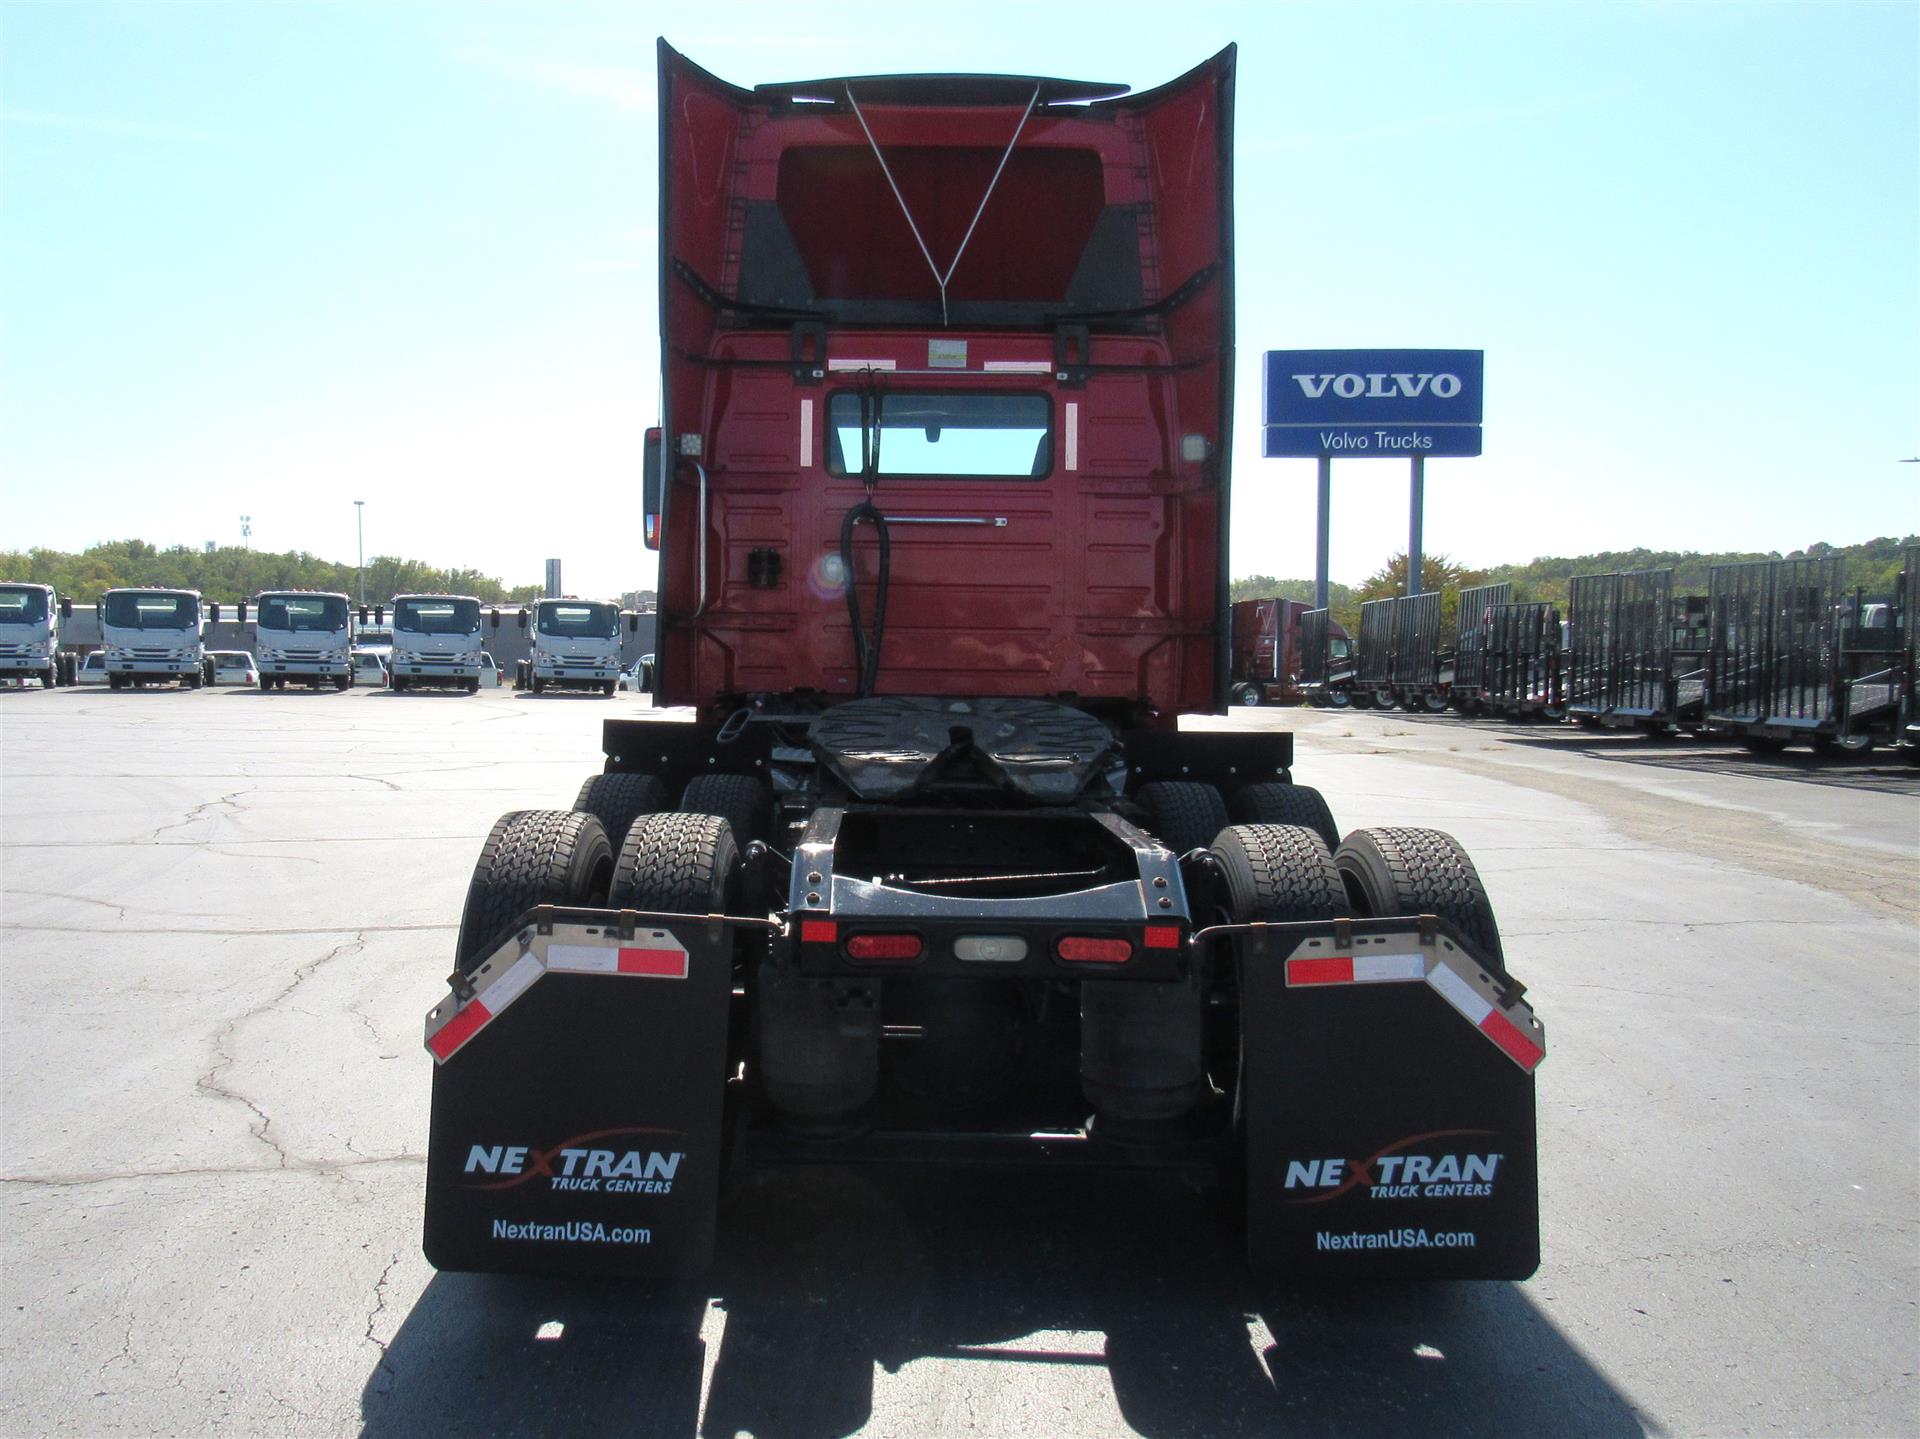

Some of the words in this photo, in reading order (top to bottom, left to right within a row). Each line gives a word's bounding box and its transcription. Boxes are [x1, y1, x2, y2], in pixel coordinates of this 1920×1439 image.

[1292, 373, 1461, 399] VOLVO
[1320, 432, 1368, 449] Volvo
[1374, 431, 1433, 449] Trucks
[464, 1145, 681, 1179] NEXTRAN
[1284, 1153, 1499, 1188] NEXTRAN
[551, 1177, 600, 1191] TRUCK
[606, 1179, 672, 1194] CENTERS
[1370, 1184, 1419, 1198] TRUCK
[1424, 1183, 1492, 1197] CENTERS
[493, 1219, 651, 1244] NextranUSA.com
[1316, 1228, 1476, 1250] NextranUSA.com
